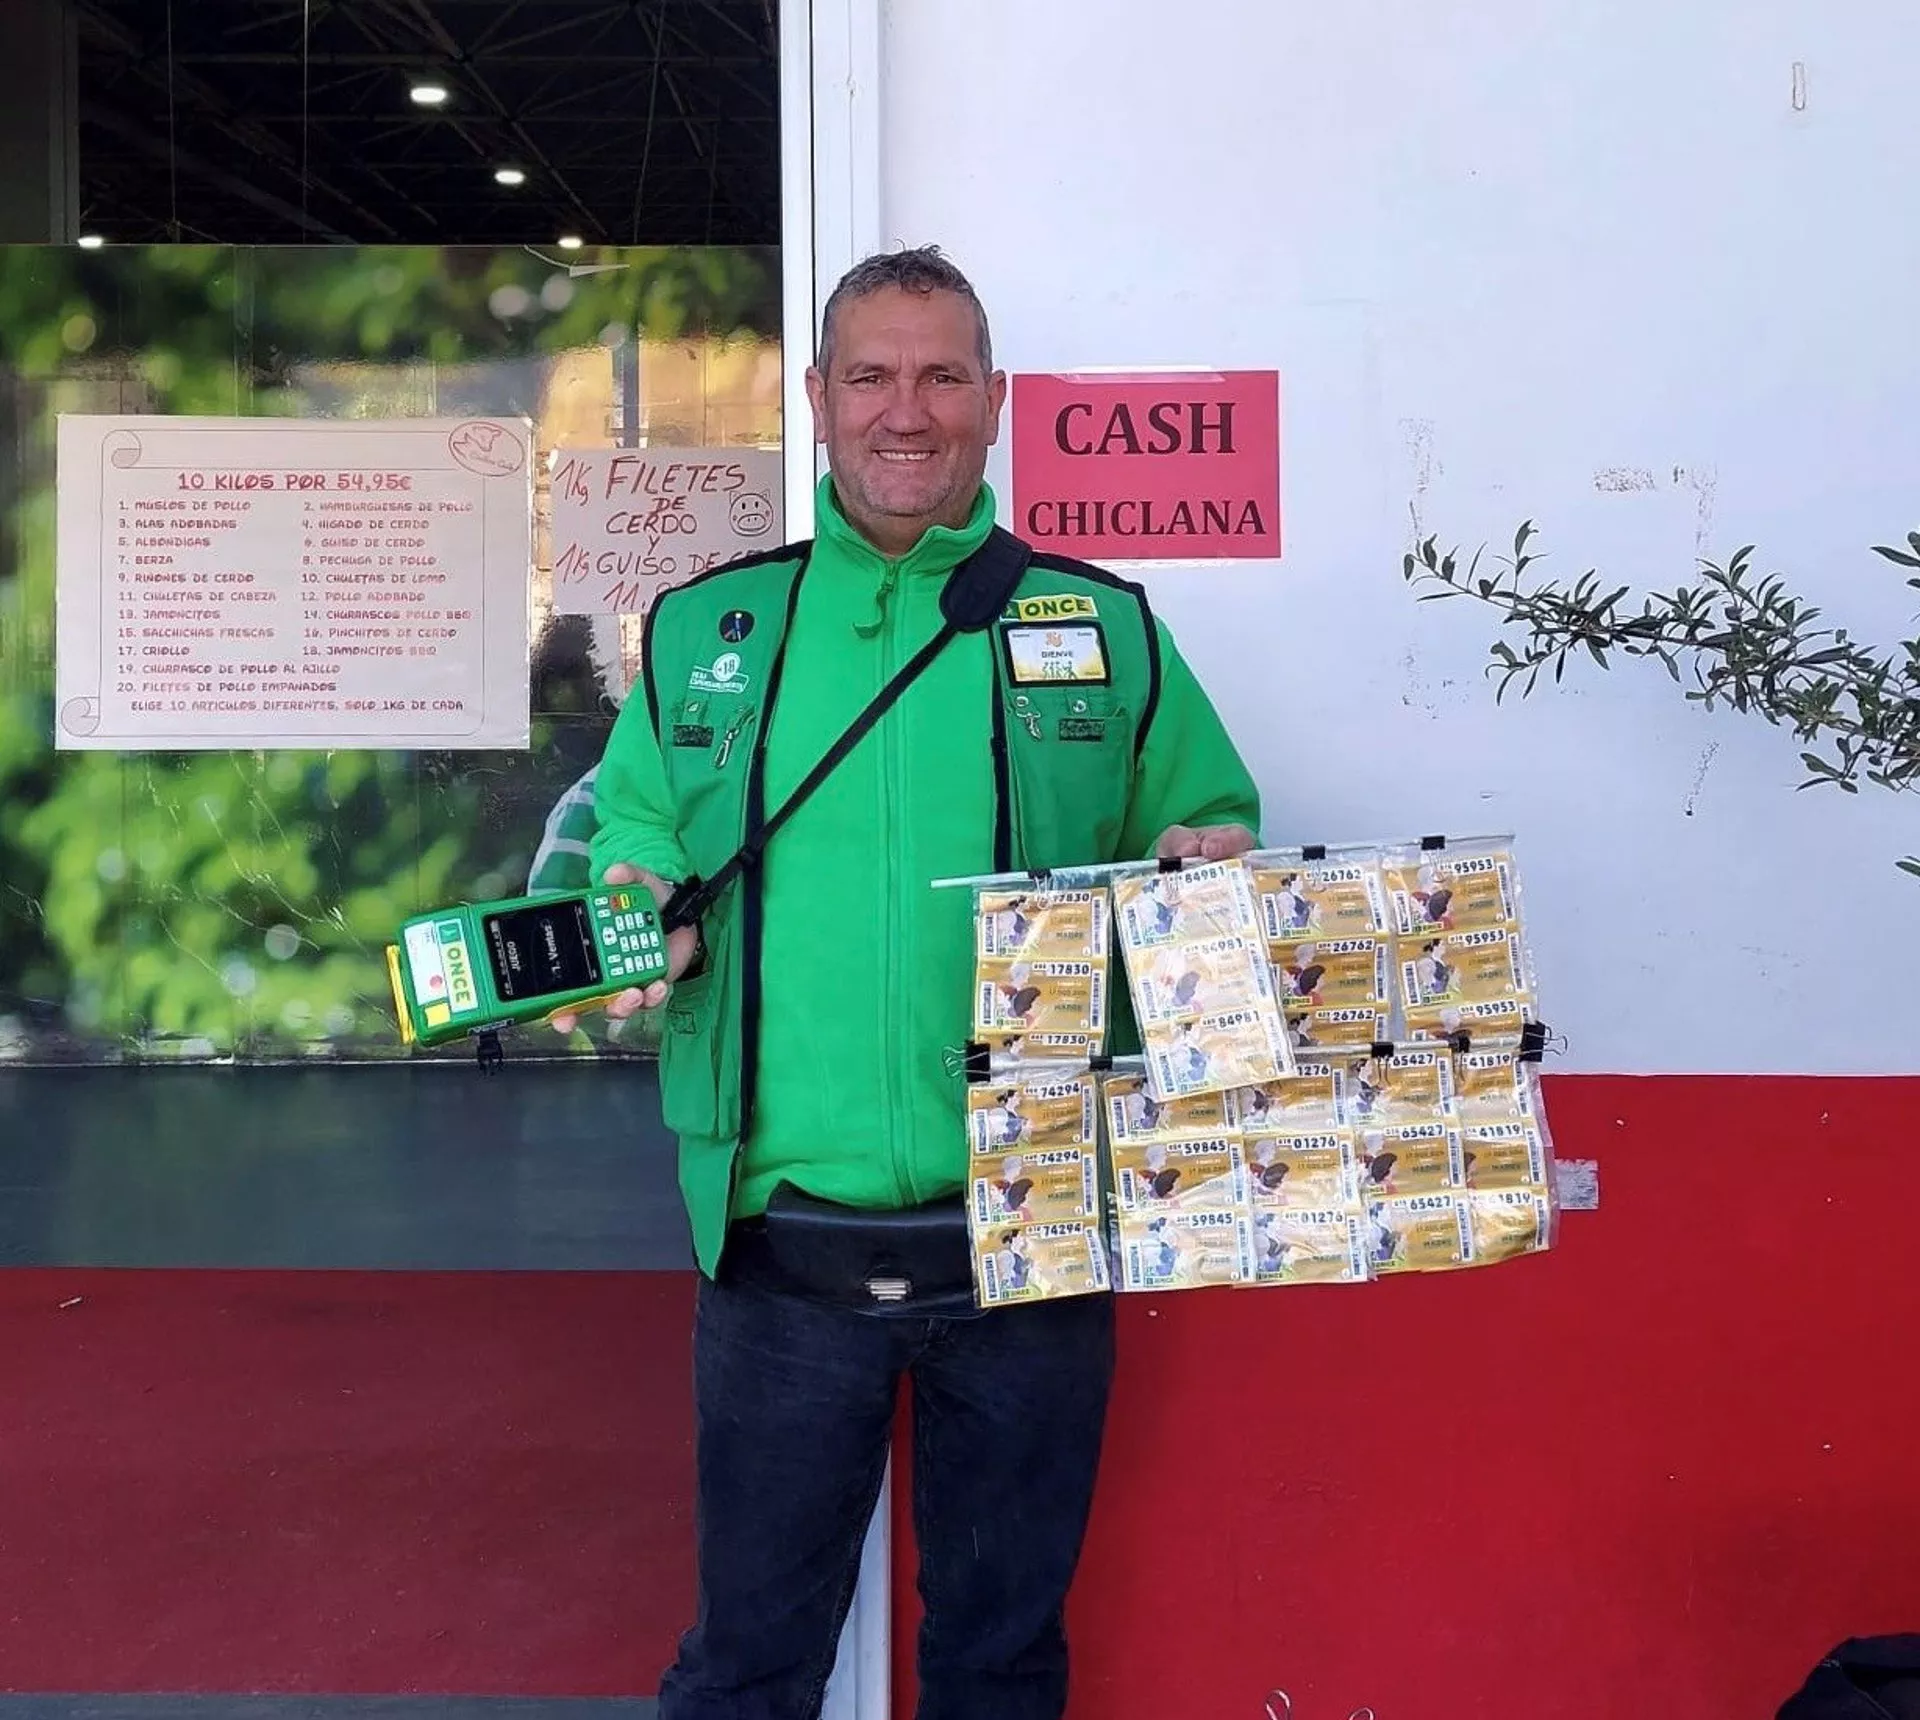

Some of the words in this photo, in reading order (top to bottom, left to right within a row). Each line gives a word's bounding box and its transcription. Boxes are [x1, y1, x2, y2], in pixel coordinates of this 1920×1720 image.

[1055, 402, 1236, 455] CASH
[178, 473, 203, 489] 10
[216, 474, 273, 489] KILOS
[287, 475, 325, 489] POR
[338, 474, 412, 492] 54,95€
[606, 456, 746, 499] FILETES
[119, 501, 128, 510] 1.
[135, 501, 186, 510] MUSLOS
[192, 501, 207, 510] DE
[215, 501, 251, 510] POLLO
[304, 503, 313, 511] 2.
[418, 503, 432, 511] DE
[653, 496, 686, 511] DE
[119, 520, 129, 528] 3.
[136, 520, 164, 528] ALAS
[171, 520, 236, 528] ADOBADAS
[606, 512, 697, 534] CERDO
[1028, 500, 1266, 536] CHICLANA
[303, 520, 312, 529] 4.
[370, 520, 383, 529] DE
[391, 520, 429, 529] CERDO
[321, 539, 358, 547] GUISO
[365, 539, 379, 547] DE
[385, 539, 424, 547] CERDO
[119, 555, 129, 565] 7.
[136, 555, 172, 565] BERZA
[303, 556, 313, 565] 8.
[320, 556, 372, 565] PECHUGA
[379, 556, 393, 565] DE
[400, 556, 436, 565] POLLO
[596, 551, 676, 575] GUISO
[689, 552, 720, 572] DE
[119, 574, 129, 582] 9.
[193, 574, 208, 582] DE
[215, 574, 253, 582] CERDO
[303, 574, 319, 583] 10.
[326, 574, 384, 583] CHULETAS
[391, 574, 405, 583] DE
[412, 574, 446, 583] LOMO
[119, 592, 136, 601] 11.
[143, 592, 201, 601] CHULETAS
[209, 592, 224, 601] DE
[230, 592, 276, 601] CABEZA
[302, 592, 319, 601] 12.
[326, 592, 361, 601] POLLO
[368, 592, 424, 601] ADOBADO
[1025, 599, 1088, 616] ONCE
[119, 610, 136, 619] 13.
[143, 610, 220, 619] JAMONCITOS
[304, 611, 320, 620] 14.
[326, 611, 400, 620] CHURRASCOS
[406, 611, 440, 620] POLLO
[447, 611, 471, 620] BBQ
[119, 628, 136, 637] 15.
[143, 628, 213, 637] SALCHICHAS
[220, 628, 274, 637] FRESCAS
[329, 629, 389, 637] PINCHITOS
[398, 629, 412, 637] DE
[418, 629, 456, 637] CERDO
[119, 647, 136, 655] 17.
[143, 647, 189, 655] CRIOLLO
[326, 647, 403, 655] JAMONCITOS
[119, 665, 136, 674] 19.
[143, 665, 210, 674] CHURRASCO
[219, 665, 233, 674] DE
[241, 665, 277, 674] POLLO
[283, 665, 295, 674] AL
[303, 664, 340, 673] AJILLO
[117, 683, 136, 692] 20.
[143, 683, 190, 692] FILETES
[198, 683, 211, 692] DE
[220, 683, 255, 692] POLLO
[262, 682, 336, 691] EMPANADOS
[131, 702, 162, 710] ELIGE
[171, 702, 186, 710] 10
[345, 701, 375, 710] SOLO
[383, 701, 404, 710] 1KG
[412, 701, 426, 710] DE
[432, 701, 462, 710] CADA
[1454, 858, 1493, 873] 95953
[1322, 870, 1361, 882] 26762
[1465, 930, 1504, 945] 95953
[1333, 940, 1372, 952] 26762
[447, 948, 470, 1002] ONCE
[1051, 964, 1089, 975] 17830
[1476, 1001, 1514, 1016] 95953
[1333, 1010, 1372, 1021] 26762
[1047, 1034, 1086, 1044] 17830
[1393, 1054, 1433, 1067] 65427
[1469, 1055, 1510, 1067] 41819
[1041, 1083, 1080, 1098] 74294
[1402, 1125, 1443, 1139] 65427
[1480, 1124, 1520, 1137] 41819
[1184, 1140, 1226, 1155] 59845
[1294, 1137, 1336, 1149] 01276
[1041, 1150, 1079, 1164] 74294
[1410, 1195, 1451, 1210] 65427
[1192, 1213, 1232, 1227] 59845
[1301, 1211, 1343, 1223] 01276
[1043, 1222, 1081, 1236] 74294
